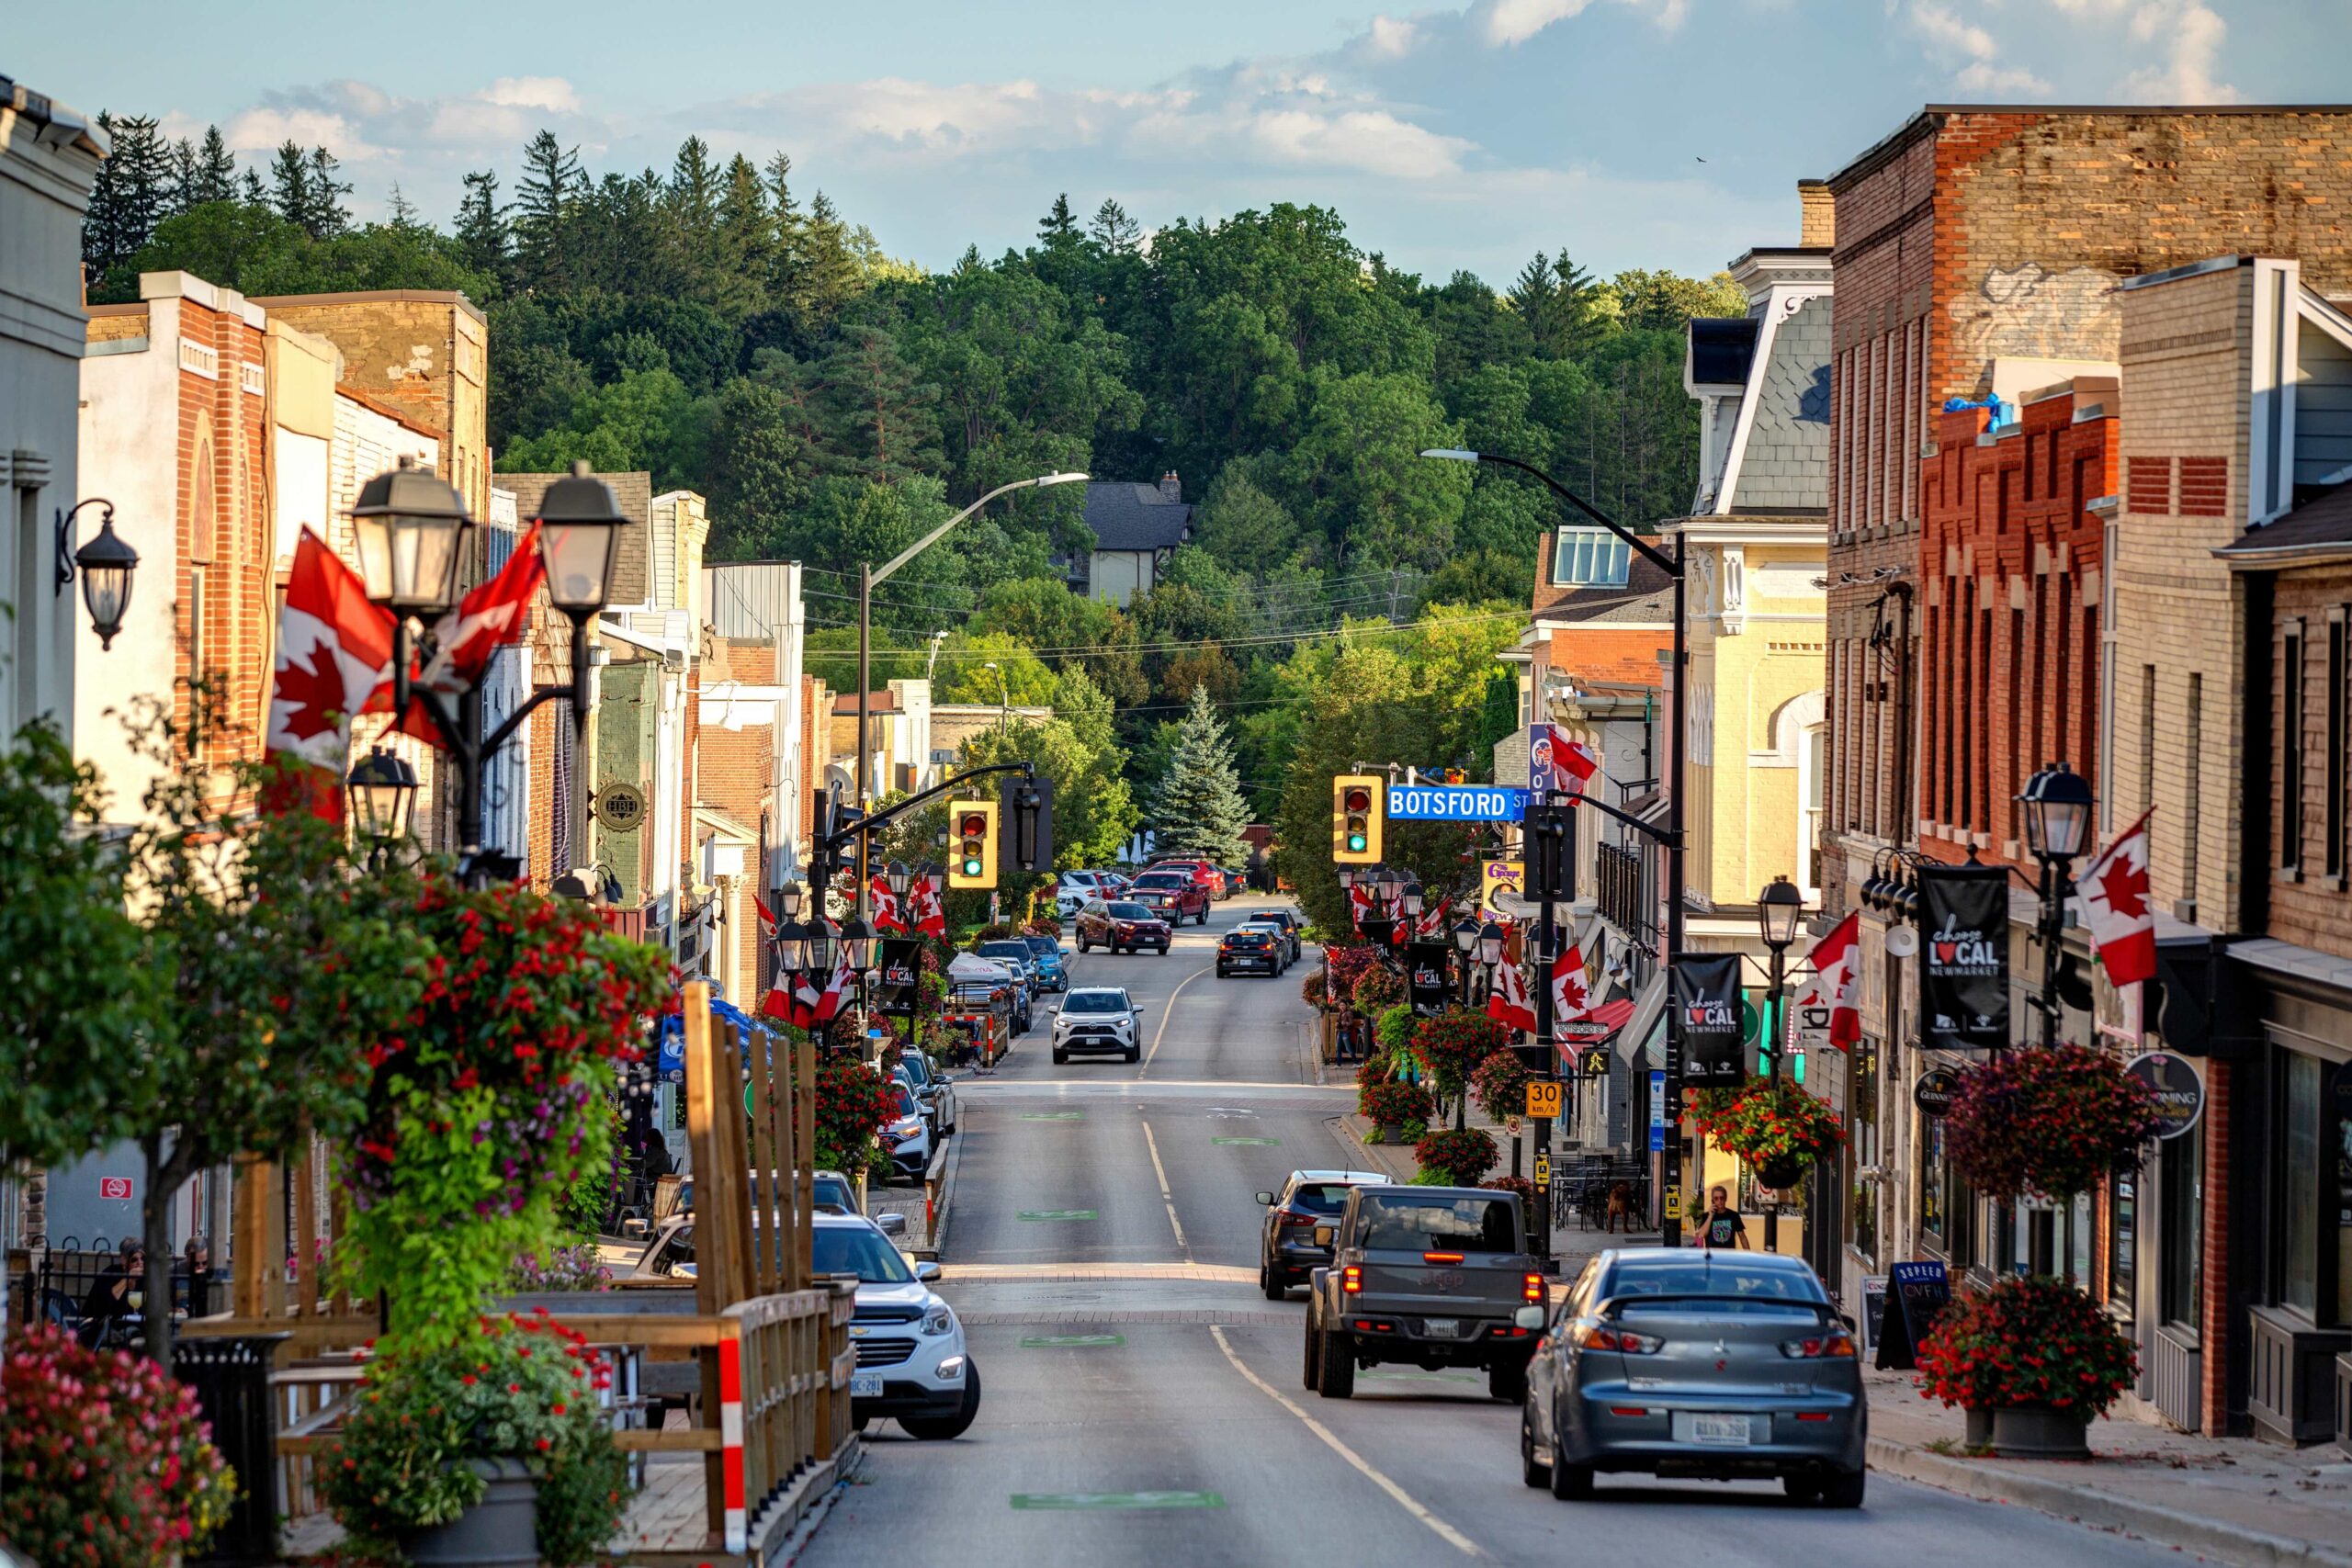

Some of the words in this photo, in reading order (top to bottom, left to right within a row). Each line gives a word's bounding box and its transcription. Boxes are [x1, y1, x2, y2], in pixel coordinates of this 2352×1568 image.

[607, 801, 636, 812] HBH
[1390, 791, 1506, 816] BOTSFORD
[1513, 795, 1529, 808] ST
[1932, 913, 1984, 943] choose
[1929, 965, 1998, 976] NEWMARKET
[1688, 987, 1724, 1010] choose
[1558, 1025, 1594, 1034] BOTSFORD
[1595, 1025, 1605, 1033] ST
[1685, 1025, 1736, 1033] NEWMARKET
[1532, 1085, 1556, 1102] 30
[1532, 1103, 1555, 1114] km/h
[1421, 1269, 1464, 1287] Jeep
